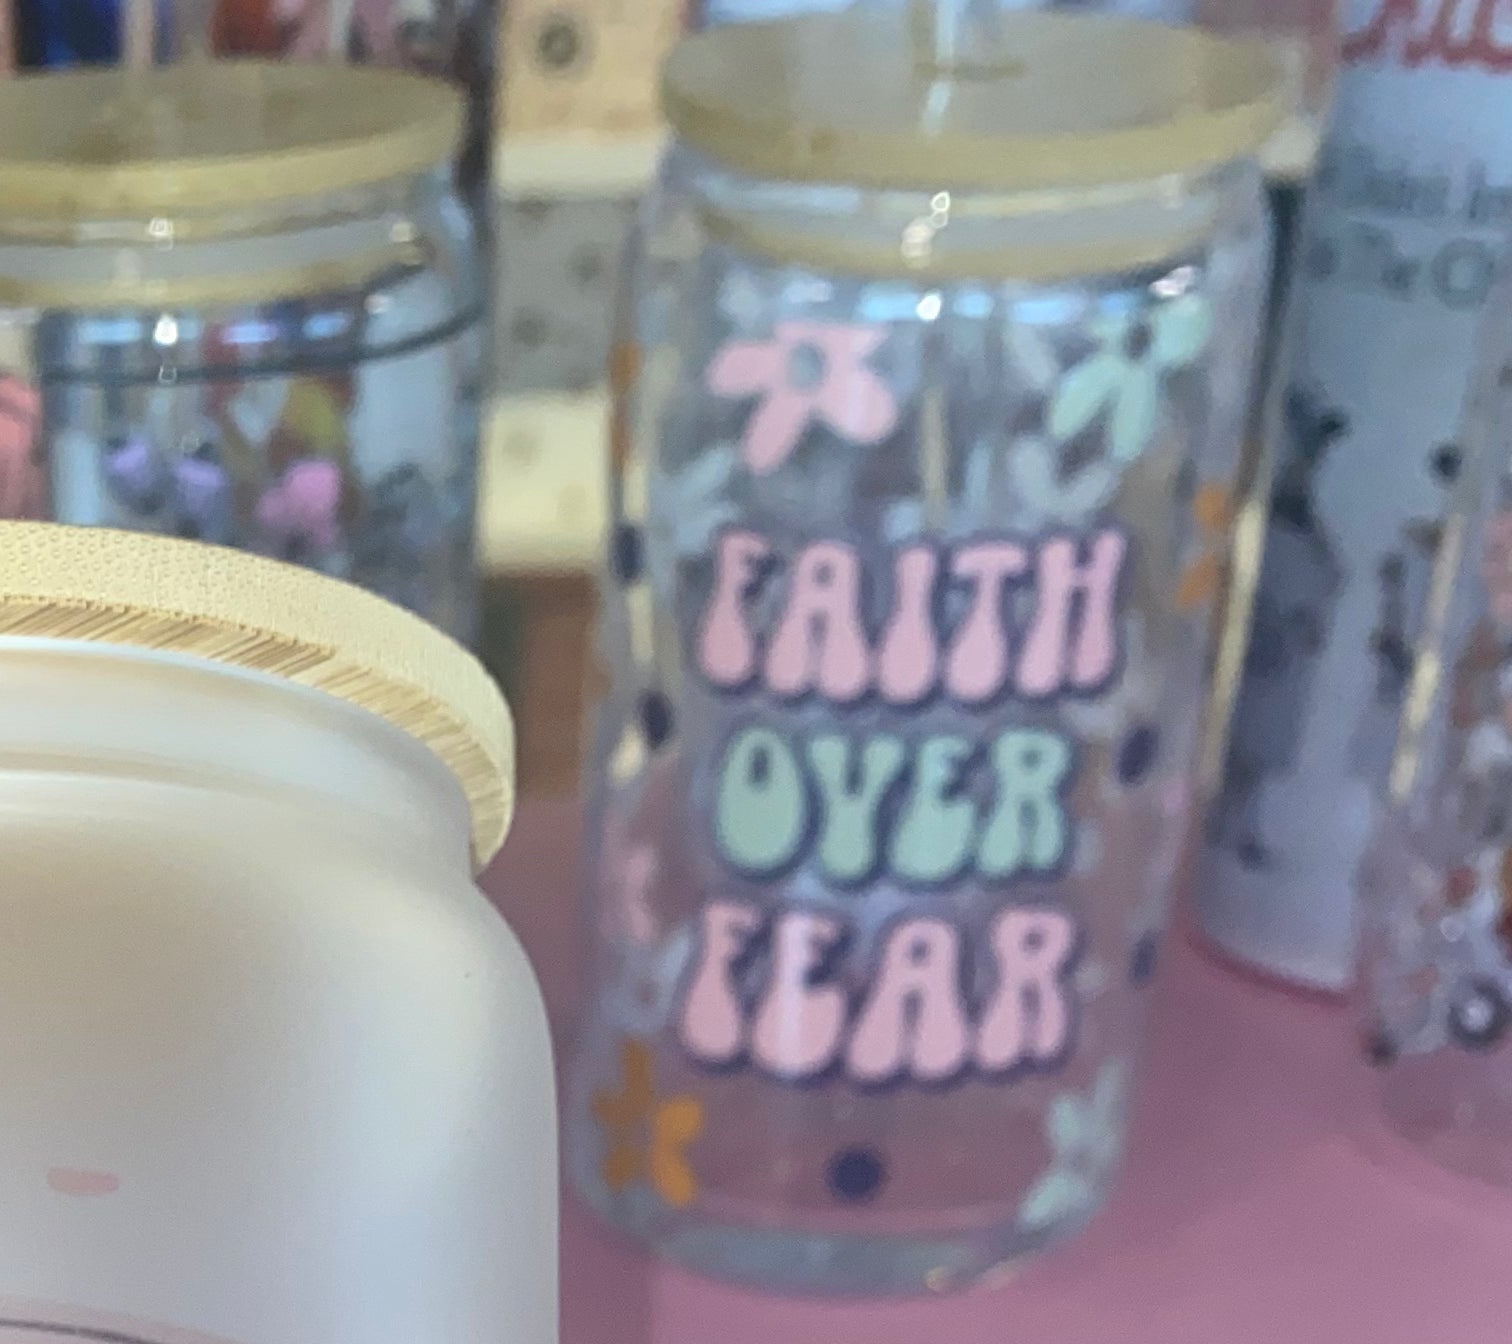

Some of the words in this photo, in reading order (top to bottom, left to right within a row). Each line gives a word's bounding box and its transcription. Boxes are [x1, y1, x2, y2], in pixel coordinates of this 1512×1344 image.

[696, 526, 1131, 706] FAITH
[714, 724, 1075, 884] OVER
[680, 900, 1078, 1084] FEAR
